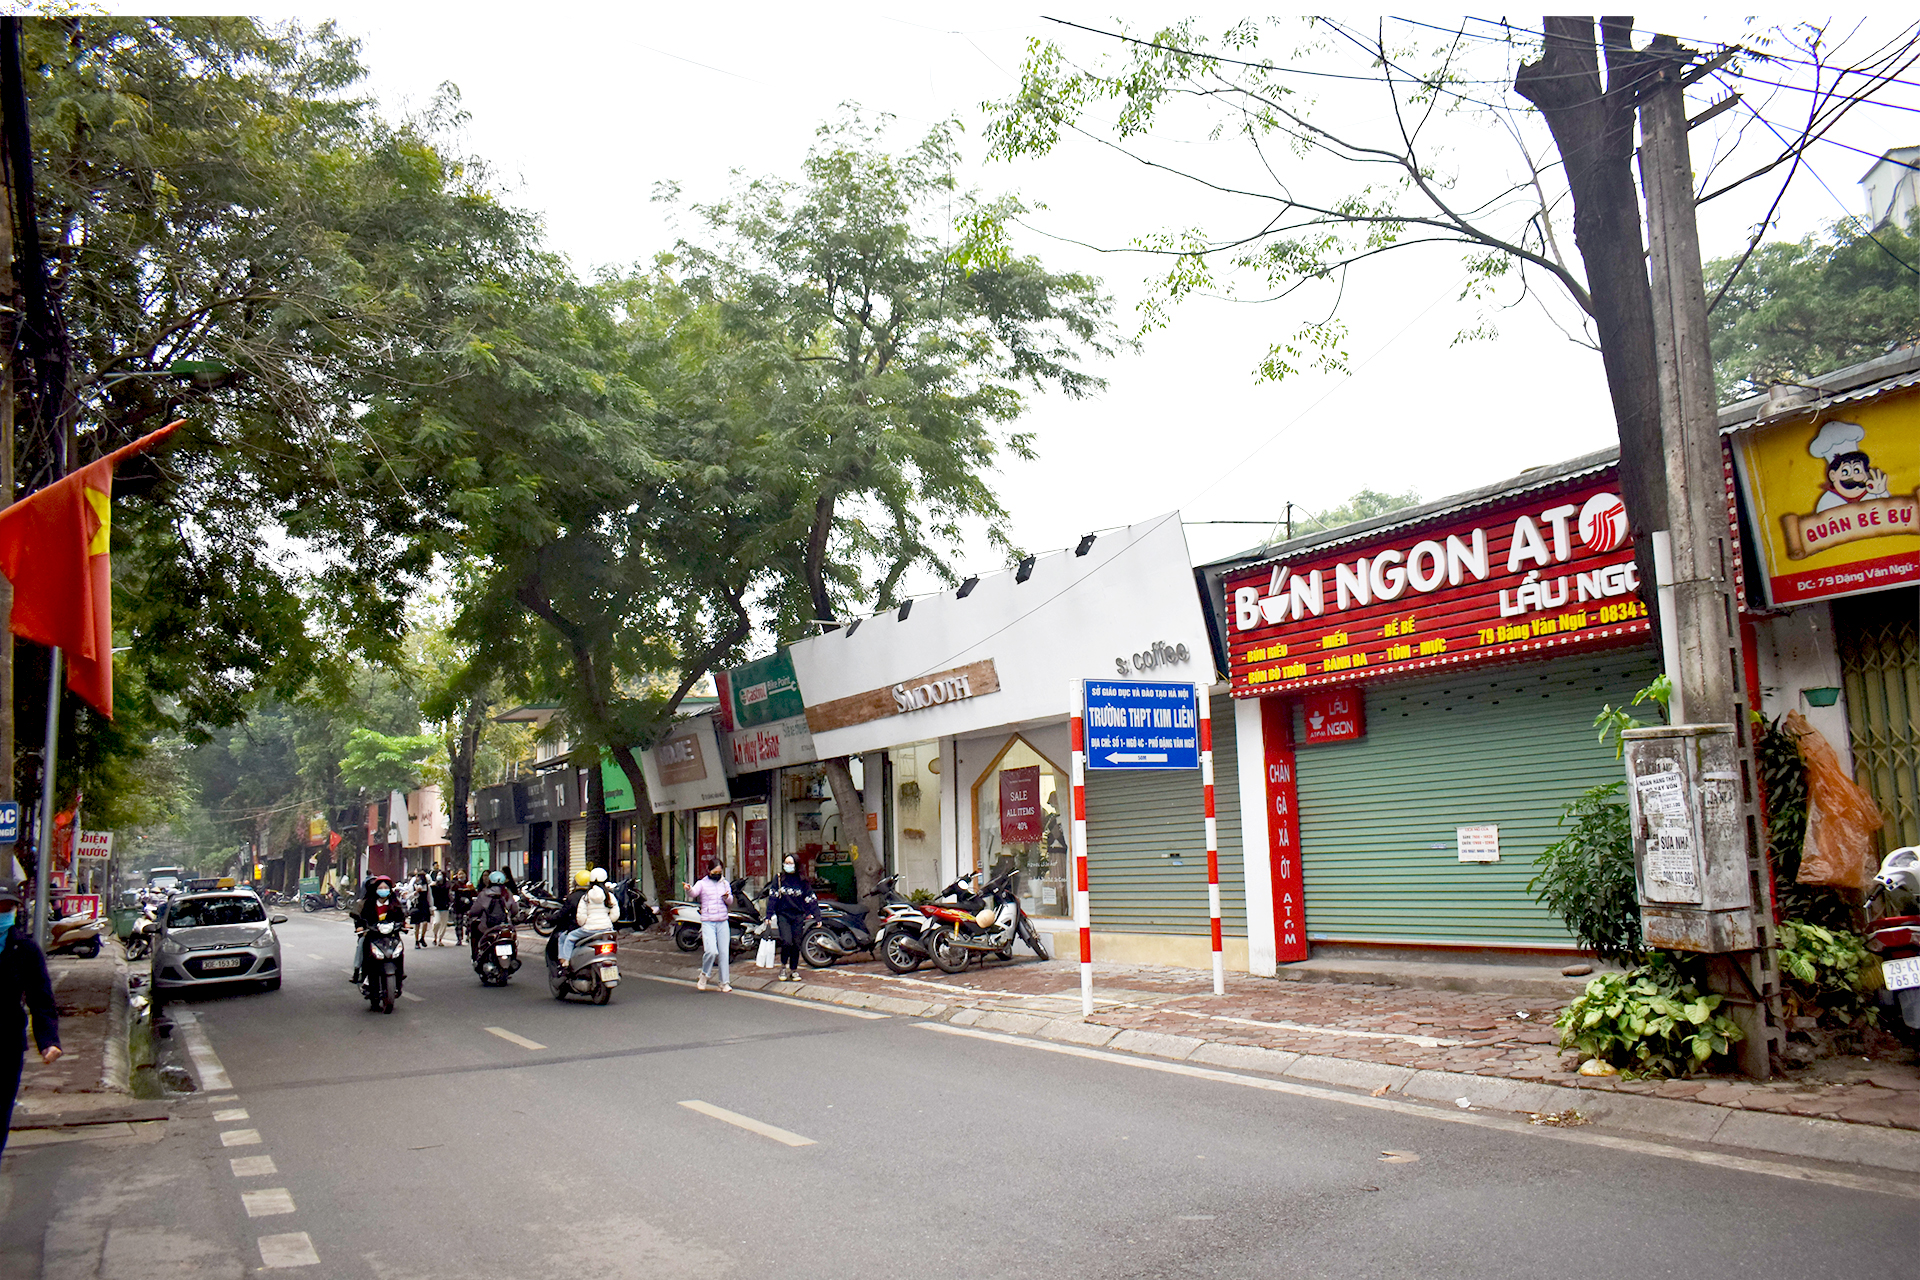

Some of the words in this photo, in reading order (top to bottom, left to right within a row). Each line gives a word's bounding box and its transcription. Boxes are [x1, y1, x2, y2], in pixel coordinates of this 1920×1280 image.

[1806, 516, 1852, 543] QUÁN
[1857, 506, 1881, 528] BÉ
[1888, 505, 1913, 527] BỰ
[1336, 528, 1490, 611] NGON
[1797, 580, 1816, 591] ĐC:
[1817, 576, 1834, 587] 79
[1835, 572, 1865, 584] Đặng
[1865, 567, 1889, 579] Văn
[1499, 570, 1569, 618] LẨU
[1576, 561, 1641, 603] NGO
[1478, 627, 1495, 645] 79
[1497, 622, 1530, 645] Đặng
[1531, 616, 1556, 636] Văn
[1558, 609, 1587, 632] Ngữ
[1600, 601, 1638, 624] 0834
[1322, 629, 1348, 649] MIẾN
[1386, 643, 1411, 661] TÔM
[1419, 637, 1447, 658] MỰC
[1132, 640, 1191, 672] coffee
[1247, 647, 1267, 663] BÚN
[1267, 642, 1288, 660] RIÊU
[1323, 654, 1351, 672] BÁNH
[1352, 652, 1368, 668] ĐA
[767, 680, 778, 690] Bike
[778, 676, 790, 687] Point
[1248, 669, 1268, 685] BÚN
[1268, 666, 1281, 682] BÒ
[1282, 661, 1307, 681] TRỘN
[745, 685, 767, 702] Castrol
[891, 675, 973, 713] SMOOTH
[1091, 684, 1101, 696] SỞ
[1102, 686, 1117, 697] GIÁO
[1118, 688, 1131, 699] DỤC
[1132, 687, 1141, 697] VÀ
[1141, 687, 1154, 698] ĐÀO
[1155, 689, 1168, 700] TẠO
[1168, 688, 1177, 698] HÀ
[1178, 688, 1189, 700] NỘI
[1089, 702, 1127, 727] TRƯỜNG
[1128, 708, 1151, 728] THPT
[1153, 708, 1172, 728] KIM
[1173, 704, 1195, 728] LIÊN
[1327, 720, 1353, 736] NGON
[1091, 738, 1100, 749] ĐỊA
[1112, 735, 1120, 748] SỐ
[1137, 738, 1145, 748] 4C
[1148, 735, 1159, 748] PHỐ
[1159, 736, 1173, 750] ĐẶNG
[1173, 737, 1184, 749] VĂN
[1184, 736, 1195, 748] NGỮ
[1269, 759, 1291, 783] CHÂN
[1010, 790, 1028, 802] SALE
[1276, 791, 1288, 815] GÀ
[1006, 807, 1017, 817] ALL
[1017, 806, 1035, 816] ITEMS
[1278, 819, 1290, 847] XẢ
[1660, 830, 1675, 850] SỬA
[1675, 832, 1690, 850] NHÀ
[77, 845, 108, 858] NƯỚC
[1280, 855, 1291, 879] ỚT
[66, 900, 79, 913] XE
[81, 899, 94, 912] GA
